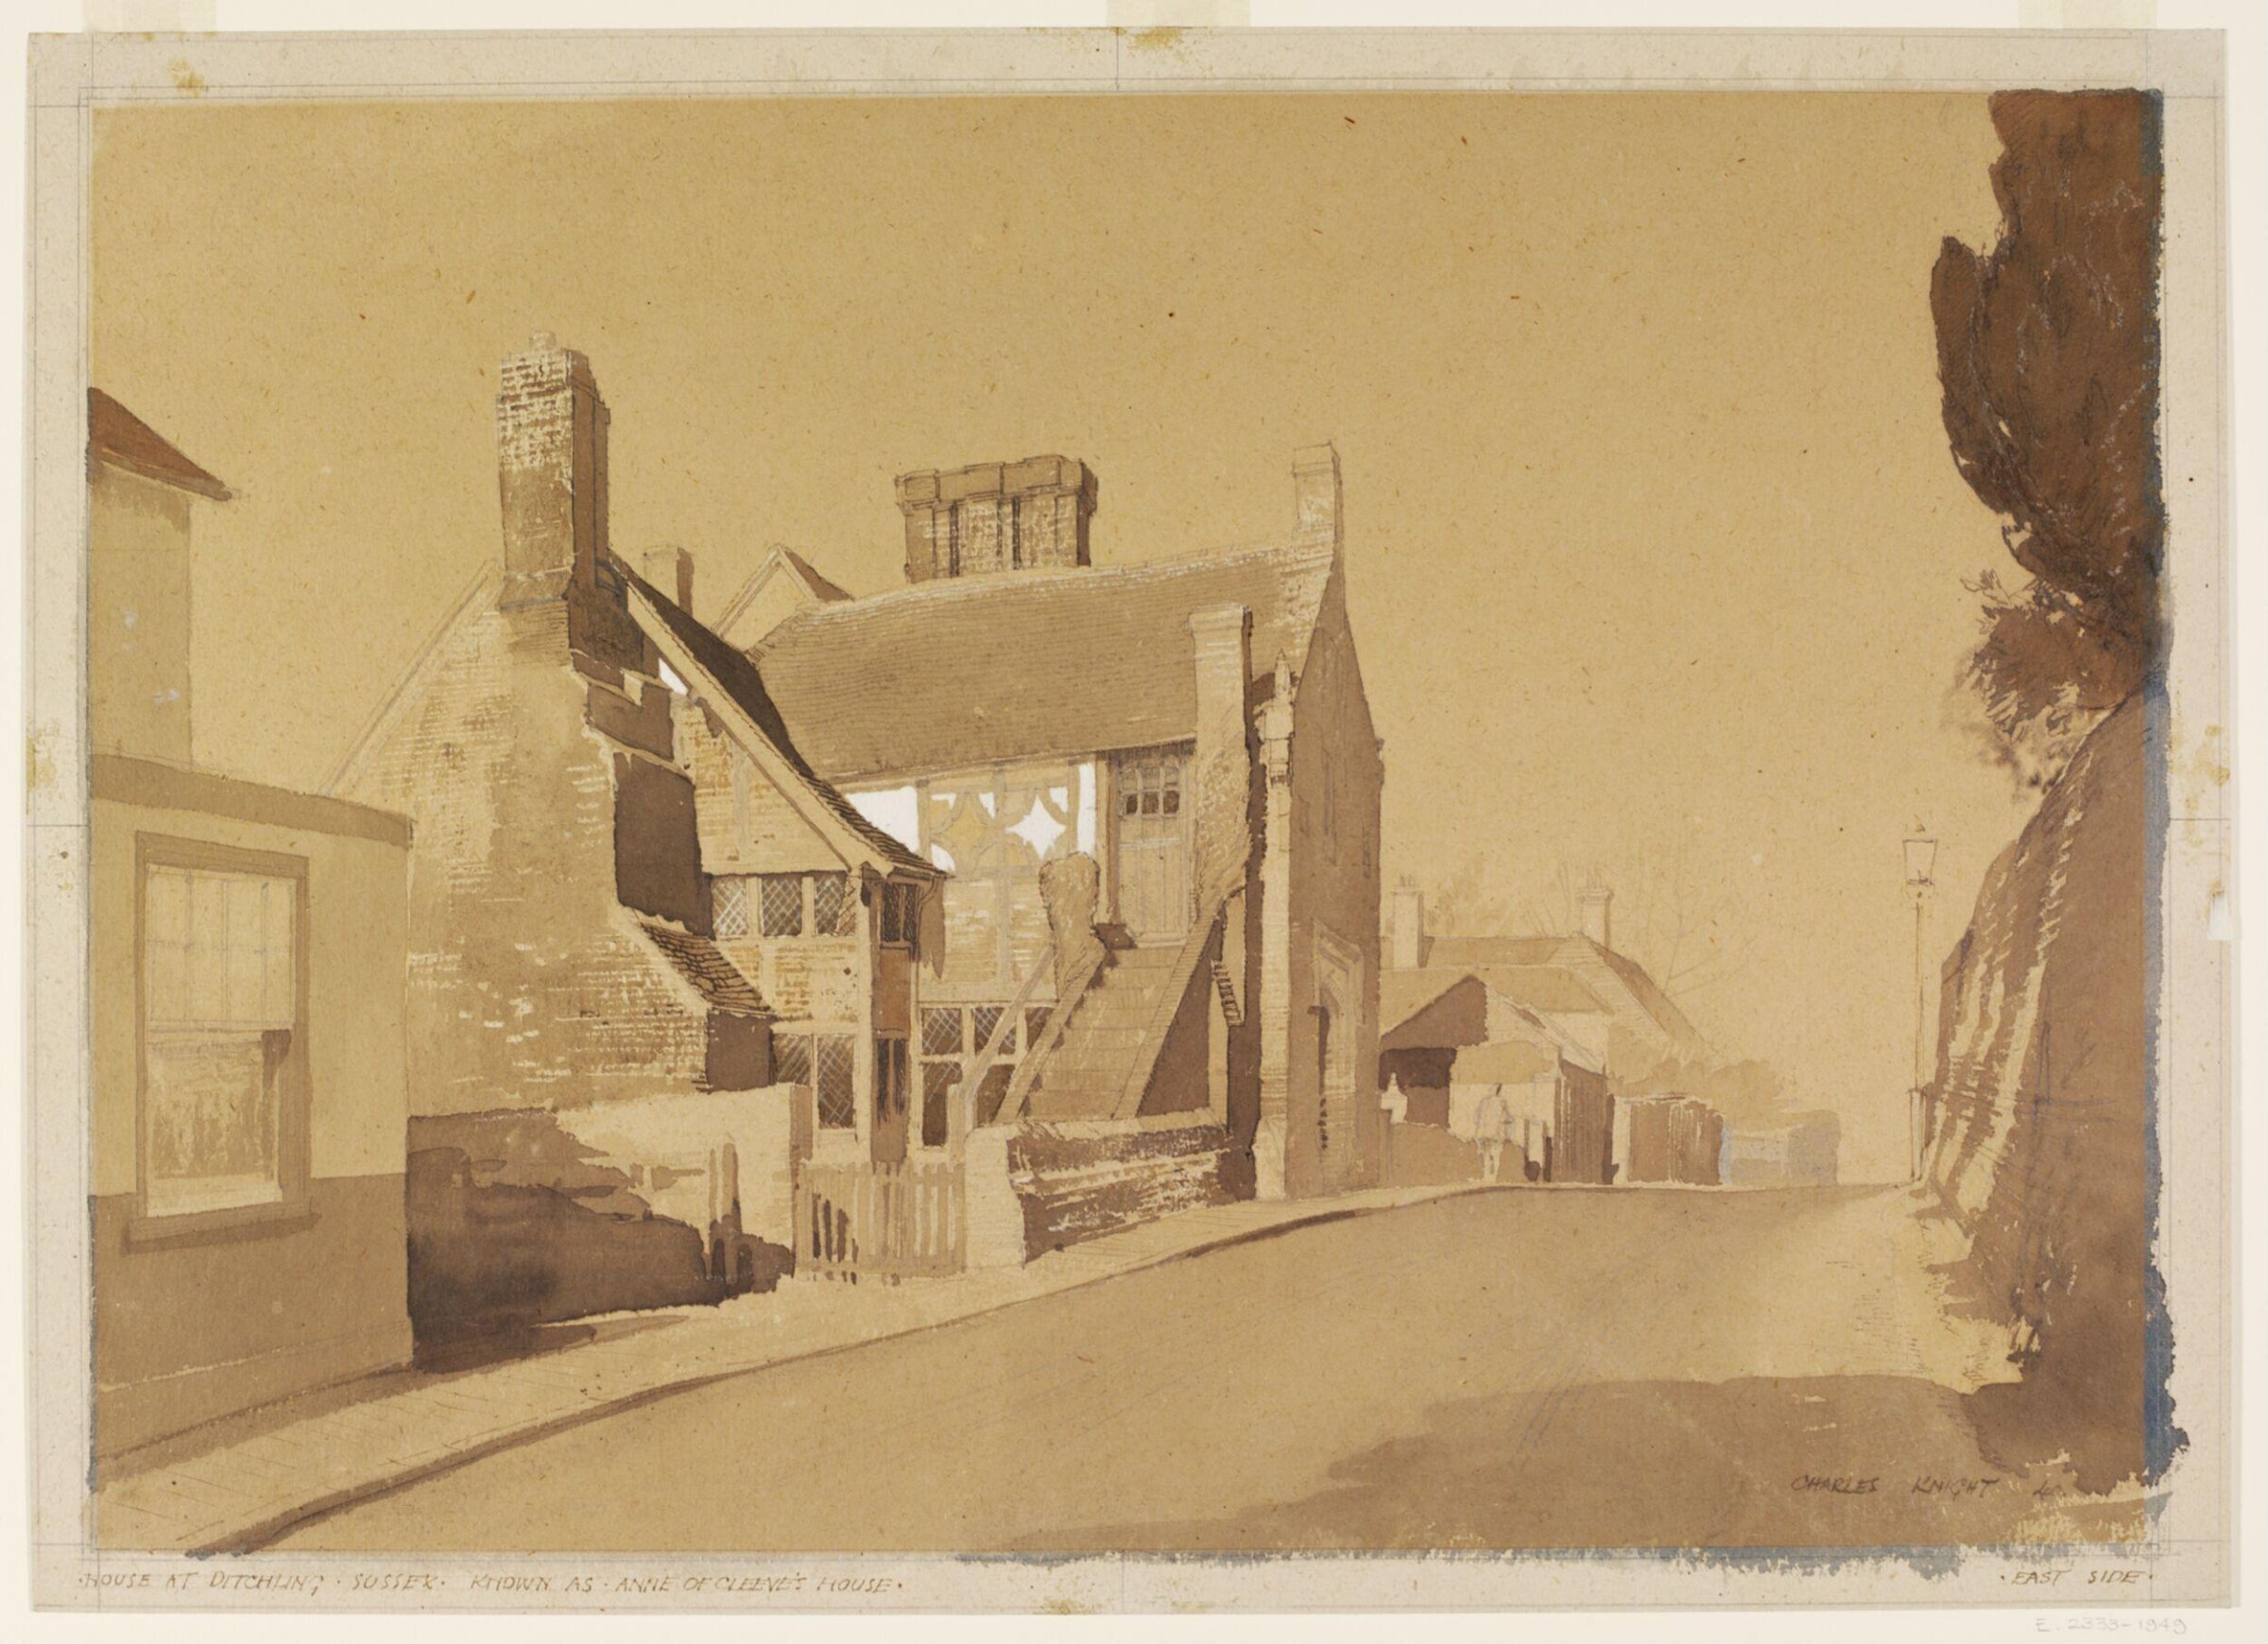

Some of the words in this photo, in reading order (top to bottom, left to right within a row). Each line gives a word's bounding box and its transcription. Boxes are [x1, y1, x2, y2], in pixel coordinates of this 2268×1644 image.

[1791, 1475, 1880, 1494] CHARLES
[1912, 1476, 2000, 1500] KNIGHT
[165, 1571, 199, 1591] AT
[471, 1572, 552, 1592] KNOWN
[565, 1575, 593, 1593] AS
[615, 1575, 679, 1593] ANNE
[682, 1575, 713, 1593] OF
